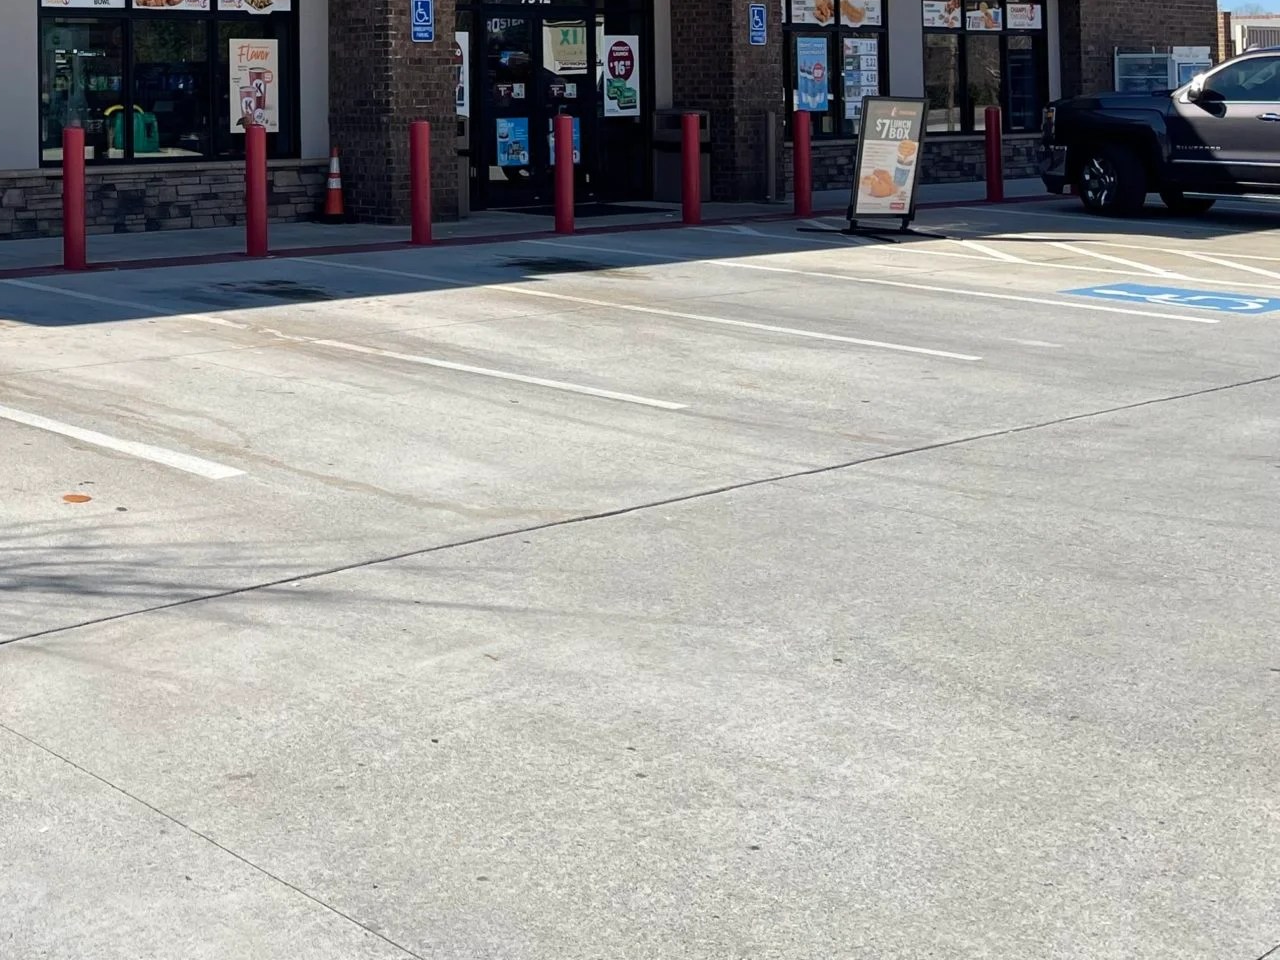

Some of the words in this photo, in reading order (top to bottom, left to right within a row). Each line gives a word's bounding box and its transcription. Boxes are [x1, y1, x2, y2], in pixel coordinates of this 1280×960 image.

[237, 44, 271, 63] Flavor
[876, 119, 890, 139] $7
[890, 120, 912, 129] LUNCH
[888, 128, 910, 139] BOX
